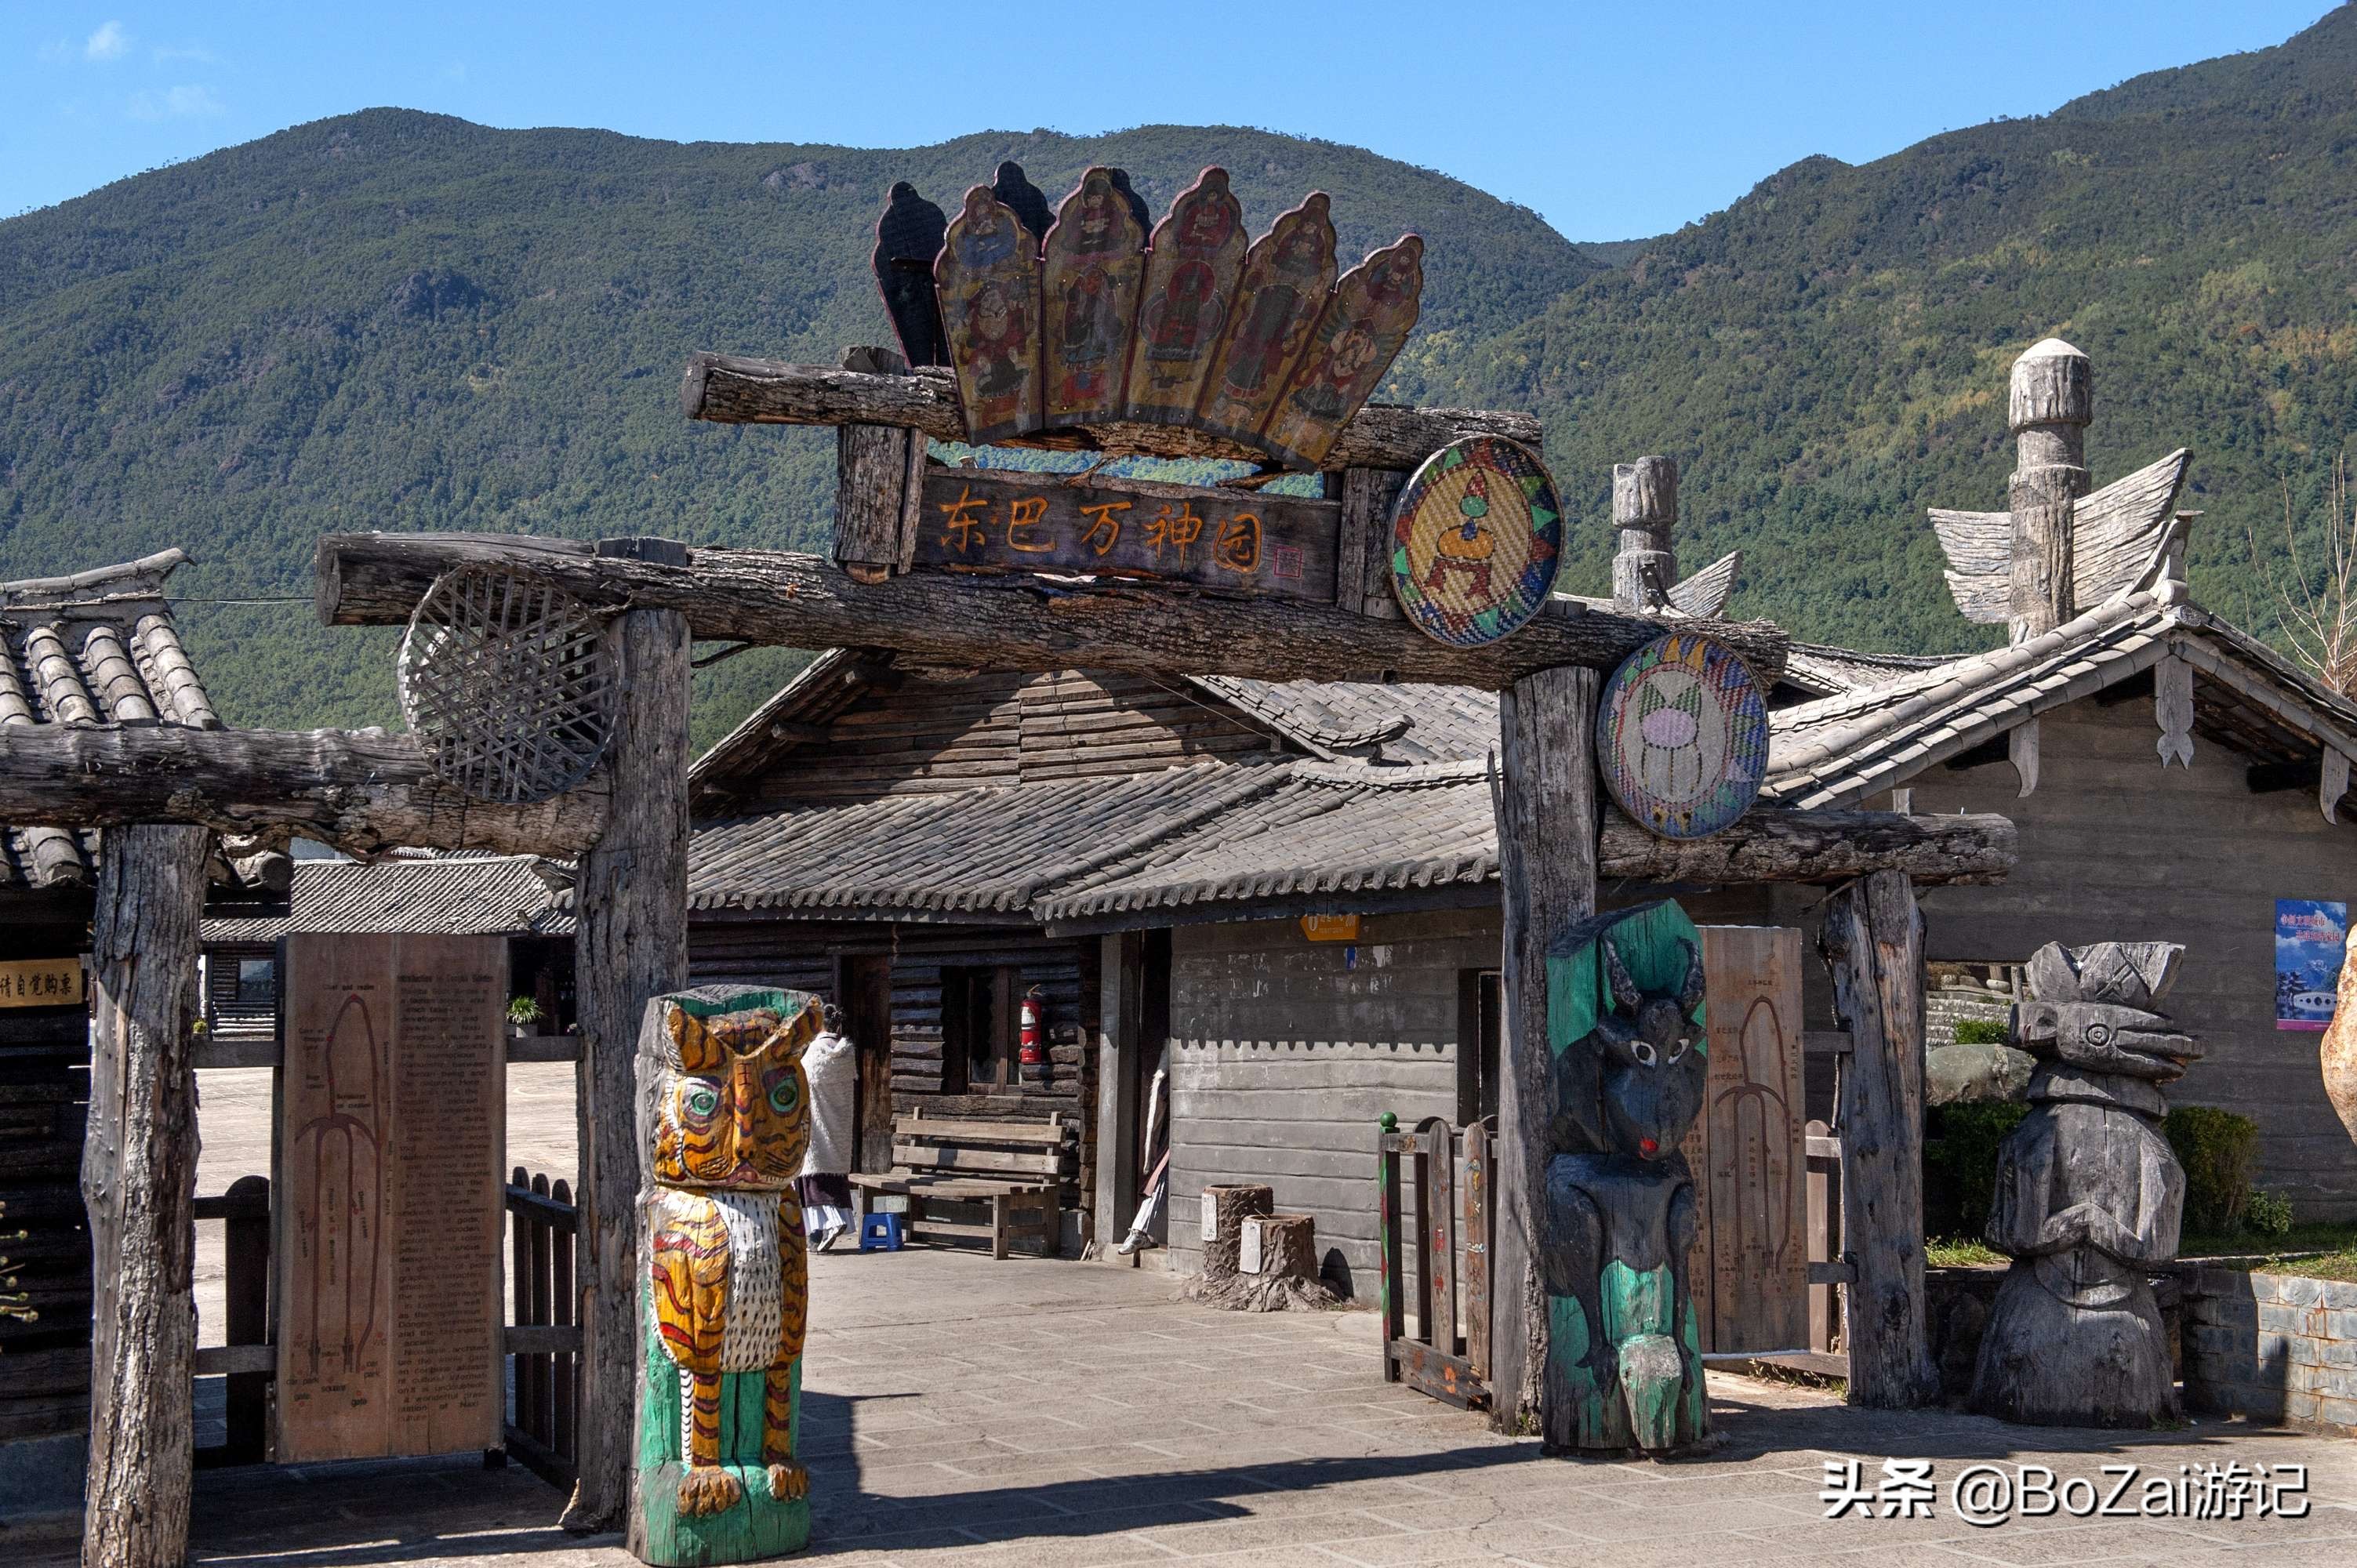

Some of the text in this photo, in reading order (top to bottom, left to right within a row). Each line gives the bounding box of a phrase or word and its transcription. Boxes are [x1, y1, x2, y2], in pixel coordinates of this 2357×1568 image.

[939, 484, 1263, 574] 东巴万神园
